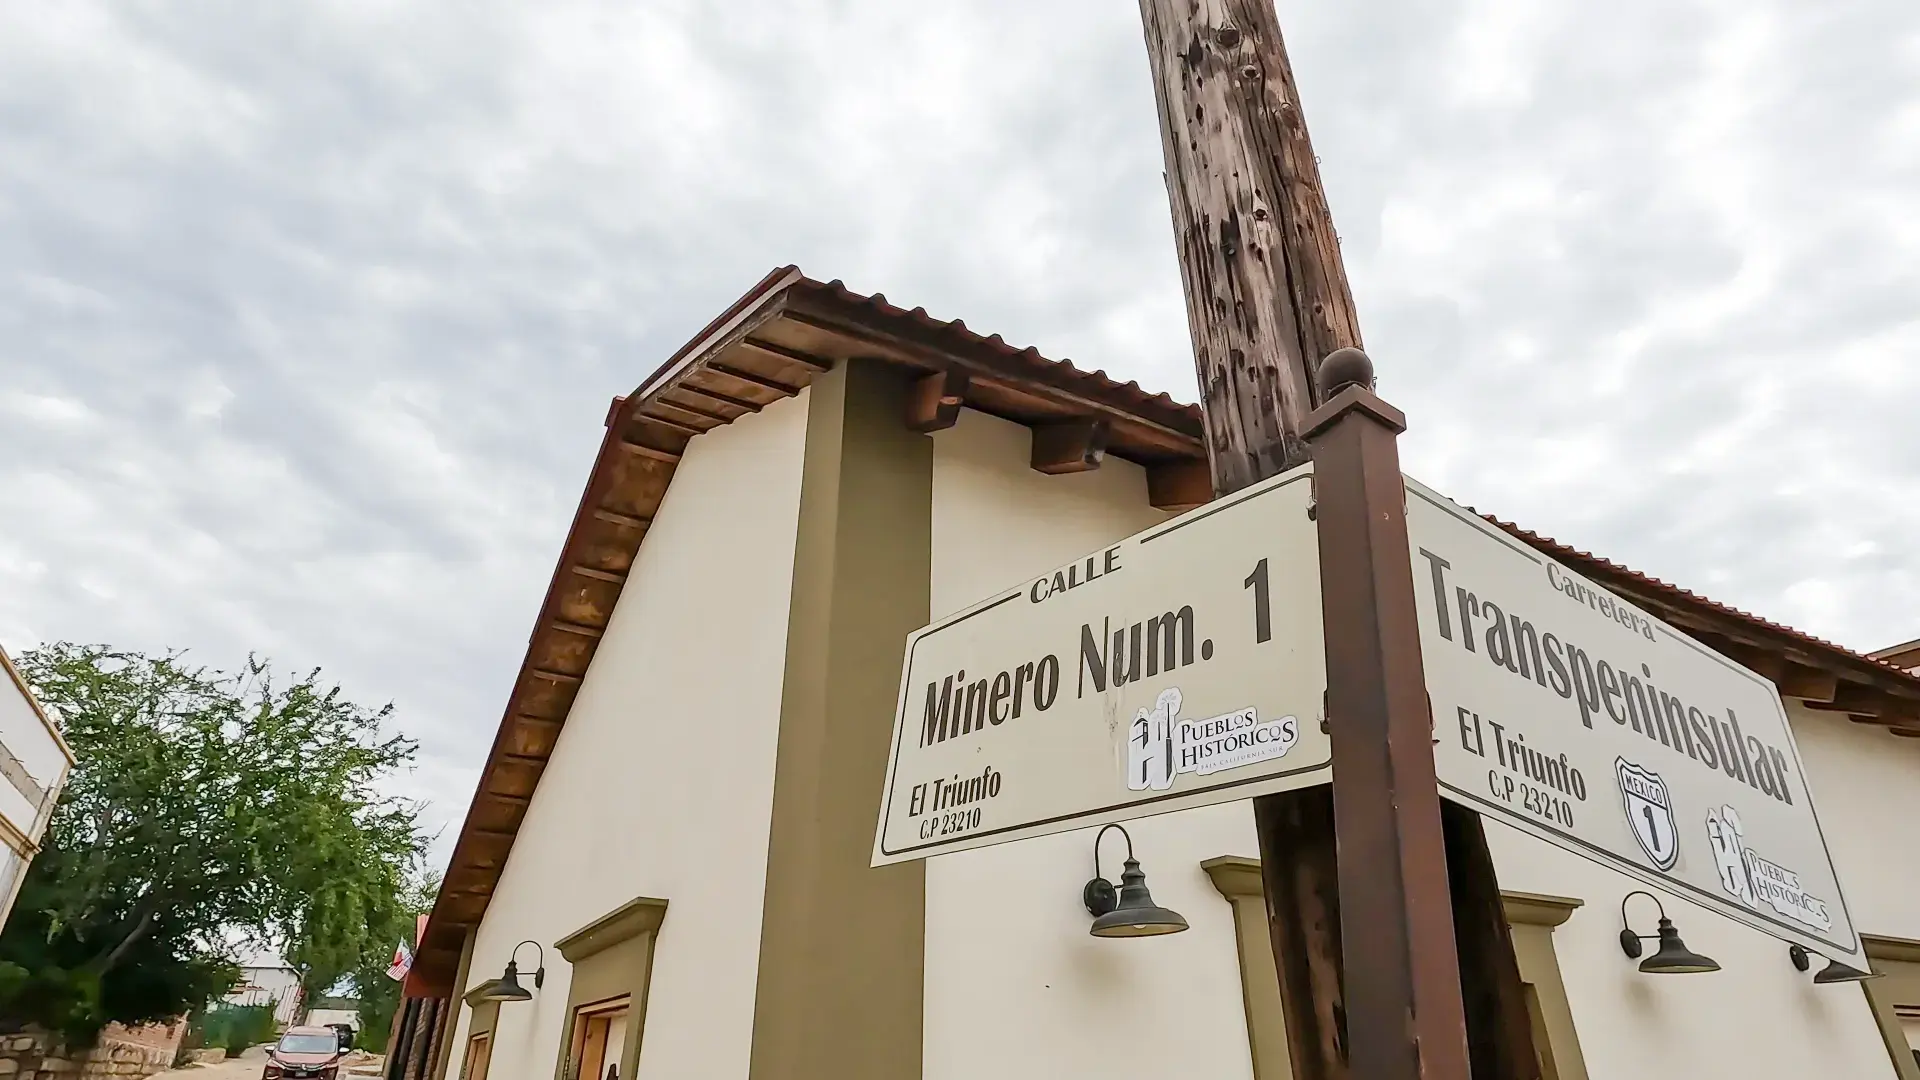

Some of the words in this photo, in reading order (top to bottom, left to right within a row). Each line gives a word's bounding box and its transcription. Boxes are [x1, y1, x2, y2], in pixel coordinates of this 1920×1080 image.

[1030, 545, 1122, 604] CALLE
[1546, 562, 1657, 643] Carretera
[919, 654, 1060, 749] Minero
[1078, 605, 1213, 699] Num.
[1244, 557, 1272, 644] 1
[1419, 547, 1793, 806] Transpeninsular
[1181, 711, 1253, 744] PUEBLOS
[1181, 721, 1294, 767] HISTÓRICOS
[1457, 705, 1485, 758] El
[1488, 720, 1586, 801] Triunfo
[909, 782, 927, 817] El
[933, 765, 1001, 812] Triunfo
[1488, 769, 1514, 802] C.P
[1520, 783, 1573, 828] 23210
[1625, 773, 1663, 804] MEXICO
[920, 817, 938, 839] C.P
[941, 807, 981, 835] 23210
[1642, 805, 1661, 852] 1
[1749, 852, 1800, 890] PUEBLS
